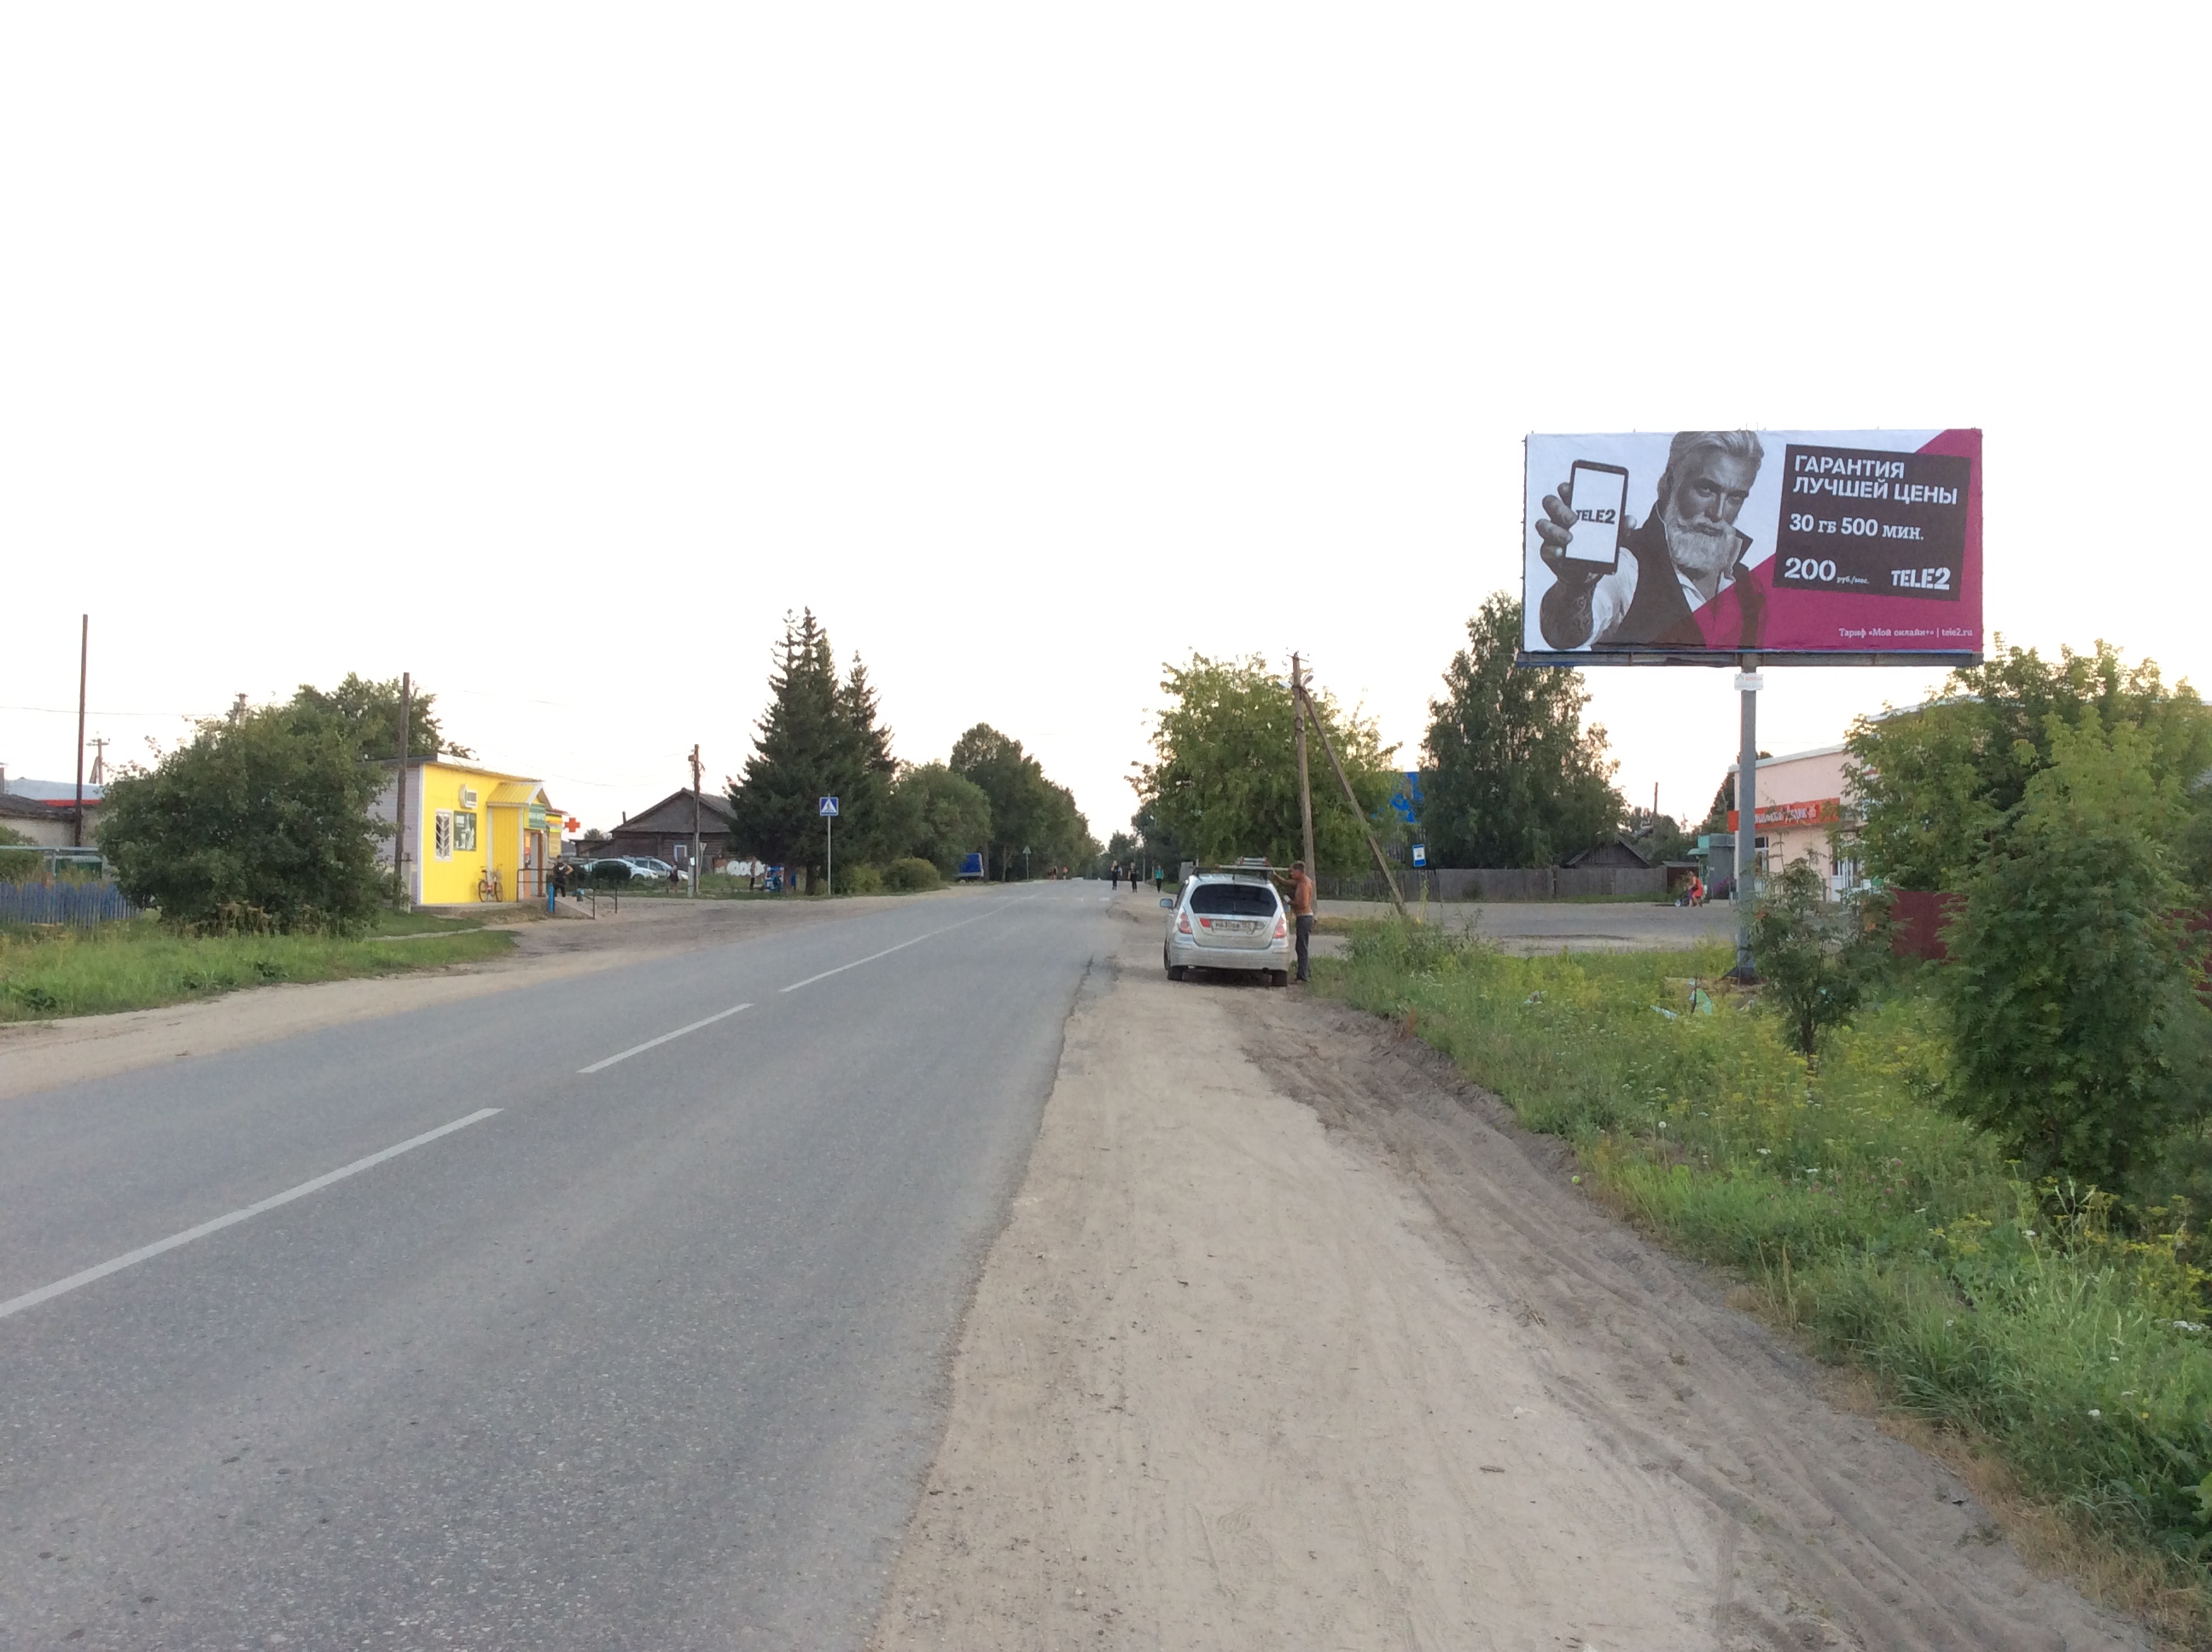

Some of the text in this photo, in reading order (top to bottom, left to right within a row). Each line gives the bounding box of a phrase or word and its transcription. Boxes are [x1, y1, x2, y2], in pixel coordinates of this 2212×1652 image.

[1795, 454, 1905, 479] ГАРАНТИЯ
[1793, 476, 1959, 505] ЛУЧШЕЙ ЦЕНЫ
[1575, 509, 1616, 525] TELE2
[1789, 513, 1814, 532] 30
[1841, 517, 1877, 537] 500
[1784, 557, 1837, 582] 200
[1891, 567, 1951, 590] TELE2
[1839, 627, 1866, 638] Тариф
[1941, 627, 1973, 637] tele2.ru
